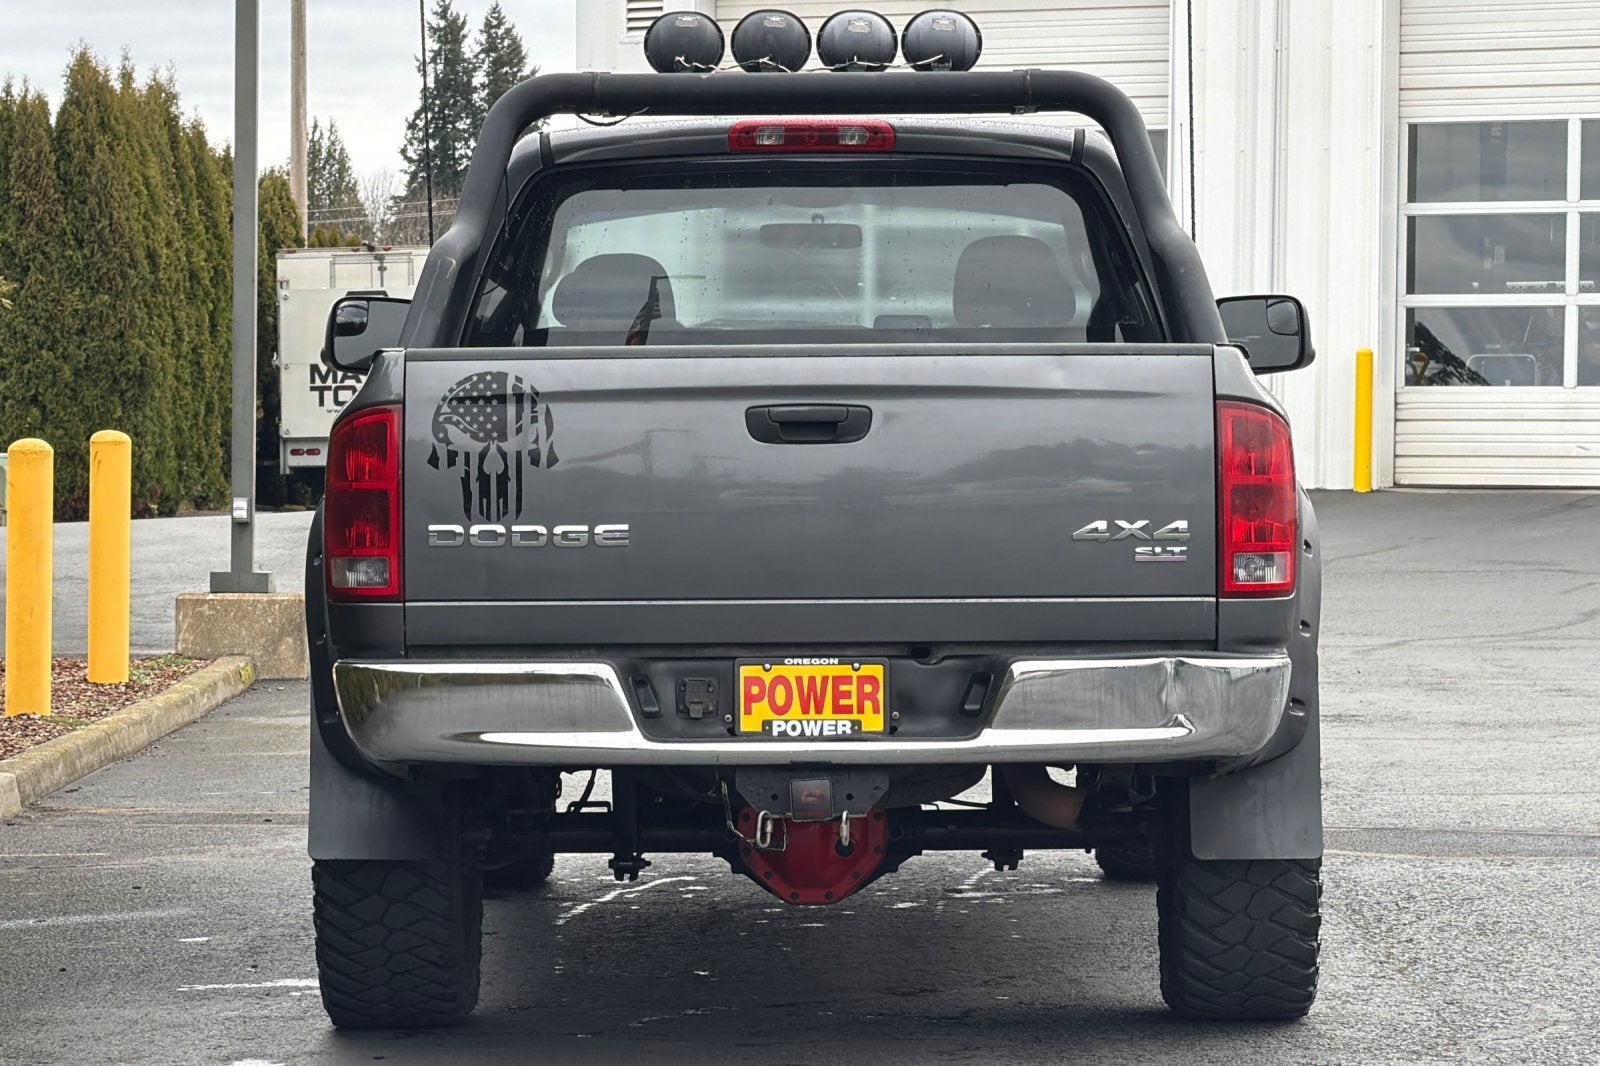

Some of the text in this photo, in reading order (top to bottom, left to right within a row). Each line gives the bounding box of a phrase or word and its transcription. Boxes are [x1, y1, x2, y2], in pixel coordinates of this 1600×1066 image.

[428, 524, 630, 547] DODGE
[1072, 520, 1190, 541] 4X4
[1134, 546, 1188, 557] SLT
[743, 675, 881, 716] POWER
[772, 720, 852, 736] POWER
